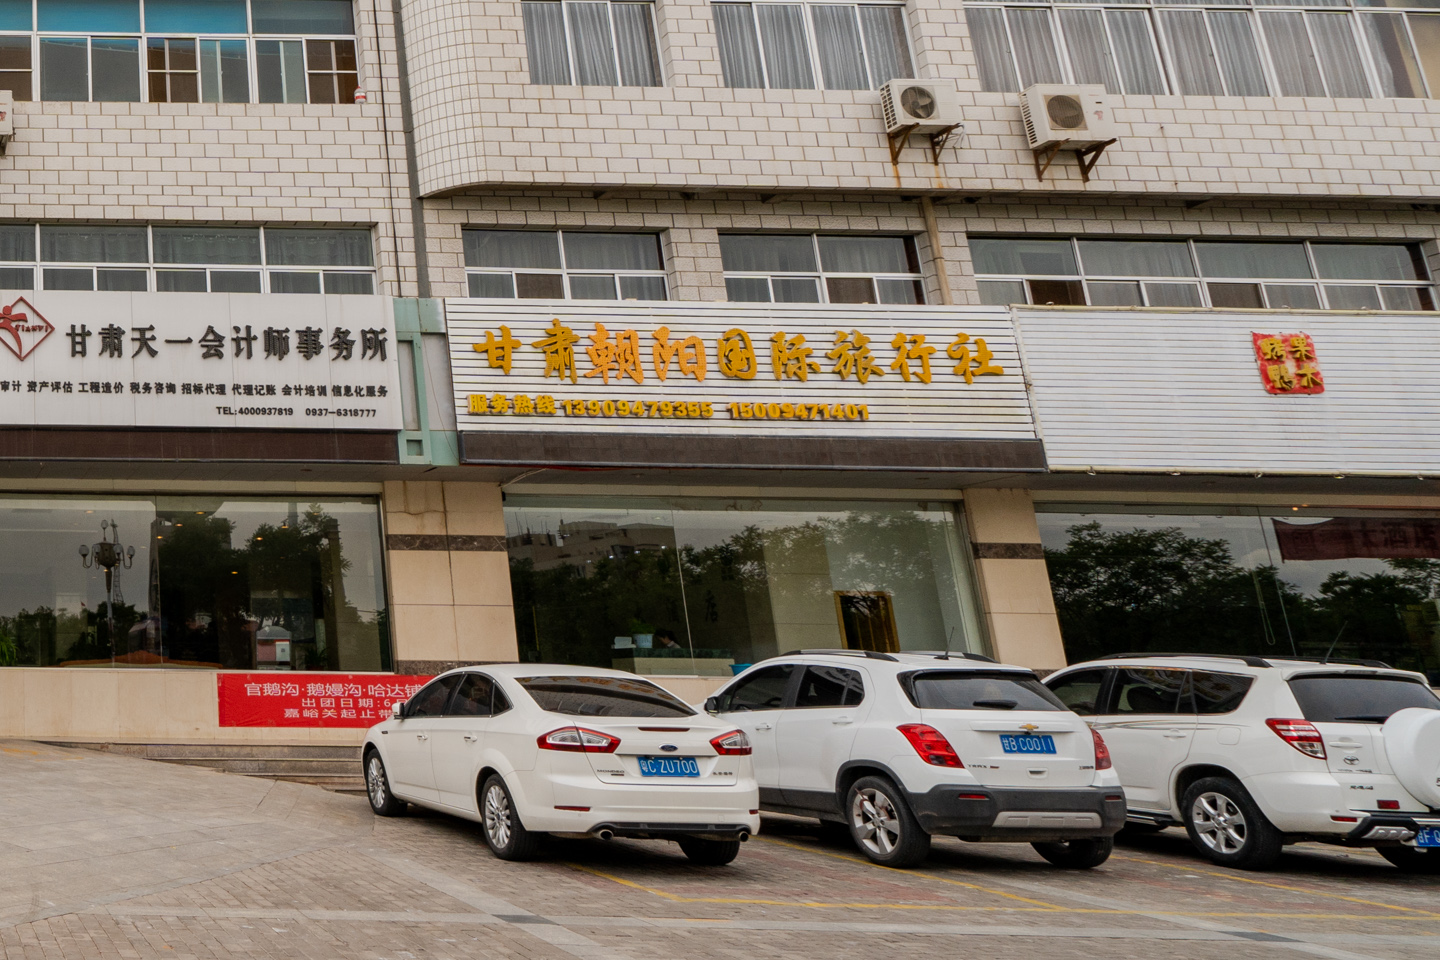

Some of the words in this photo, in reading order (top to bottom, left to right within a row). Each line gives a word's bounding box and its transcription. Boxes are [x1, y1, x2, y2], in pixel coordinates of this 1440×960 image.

[66, 324, 388, 362] 甘肃天一会计师事务所
[472, 317, 1005, 386] 甘肃朝阳国际旅行社
[27, 380, 73, 393] 资产评估
[78, 381, 124, 394] 工程造价
[130, 381, 176, 394] 税务咨询
[181, 383, 227, 395] 招标代理
[231, 383, 277, 396] 代理记账
[281, 384, 327, 397] 会计培训
[331, 385, 388, 398] 信息化服务
[466, 393, 557, 415] 服务热线
[562, 399, 714, 418] 13909479355
[726, 401, 870, 421] 15009471401
